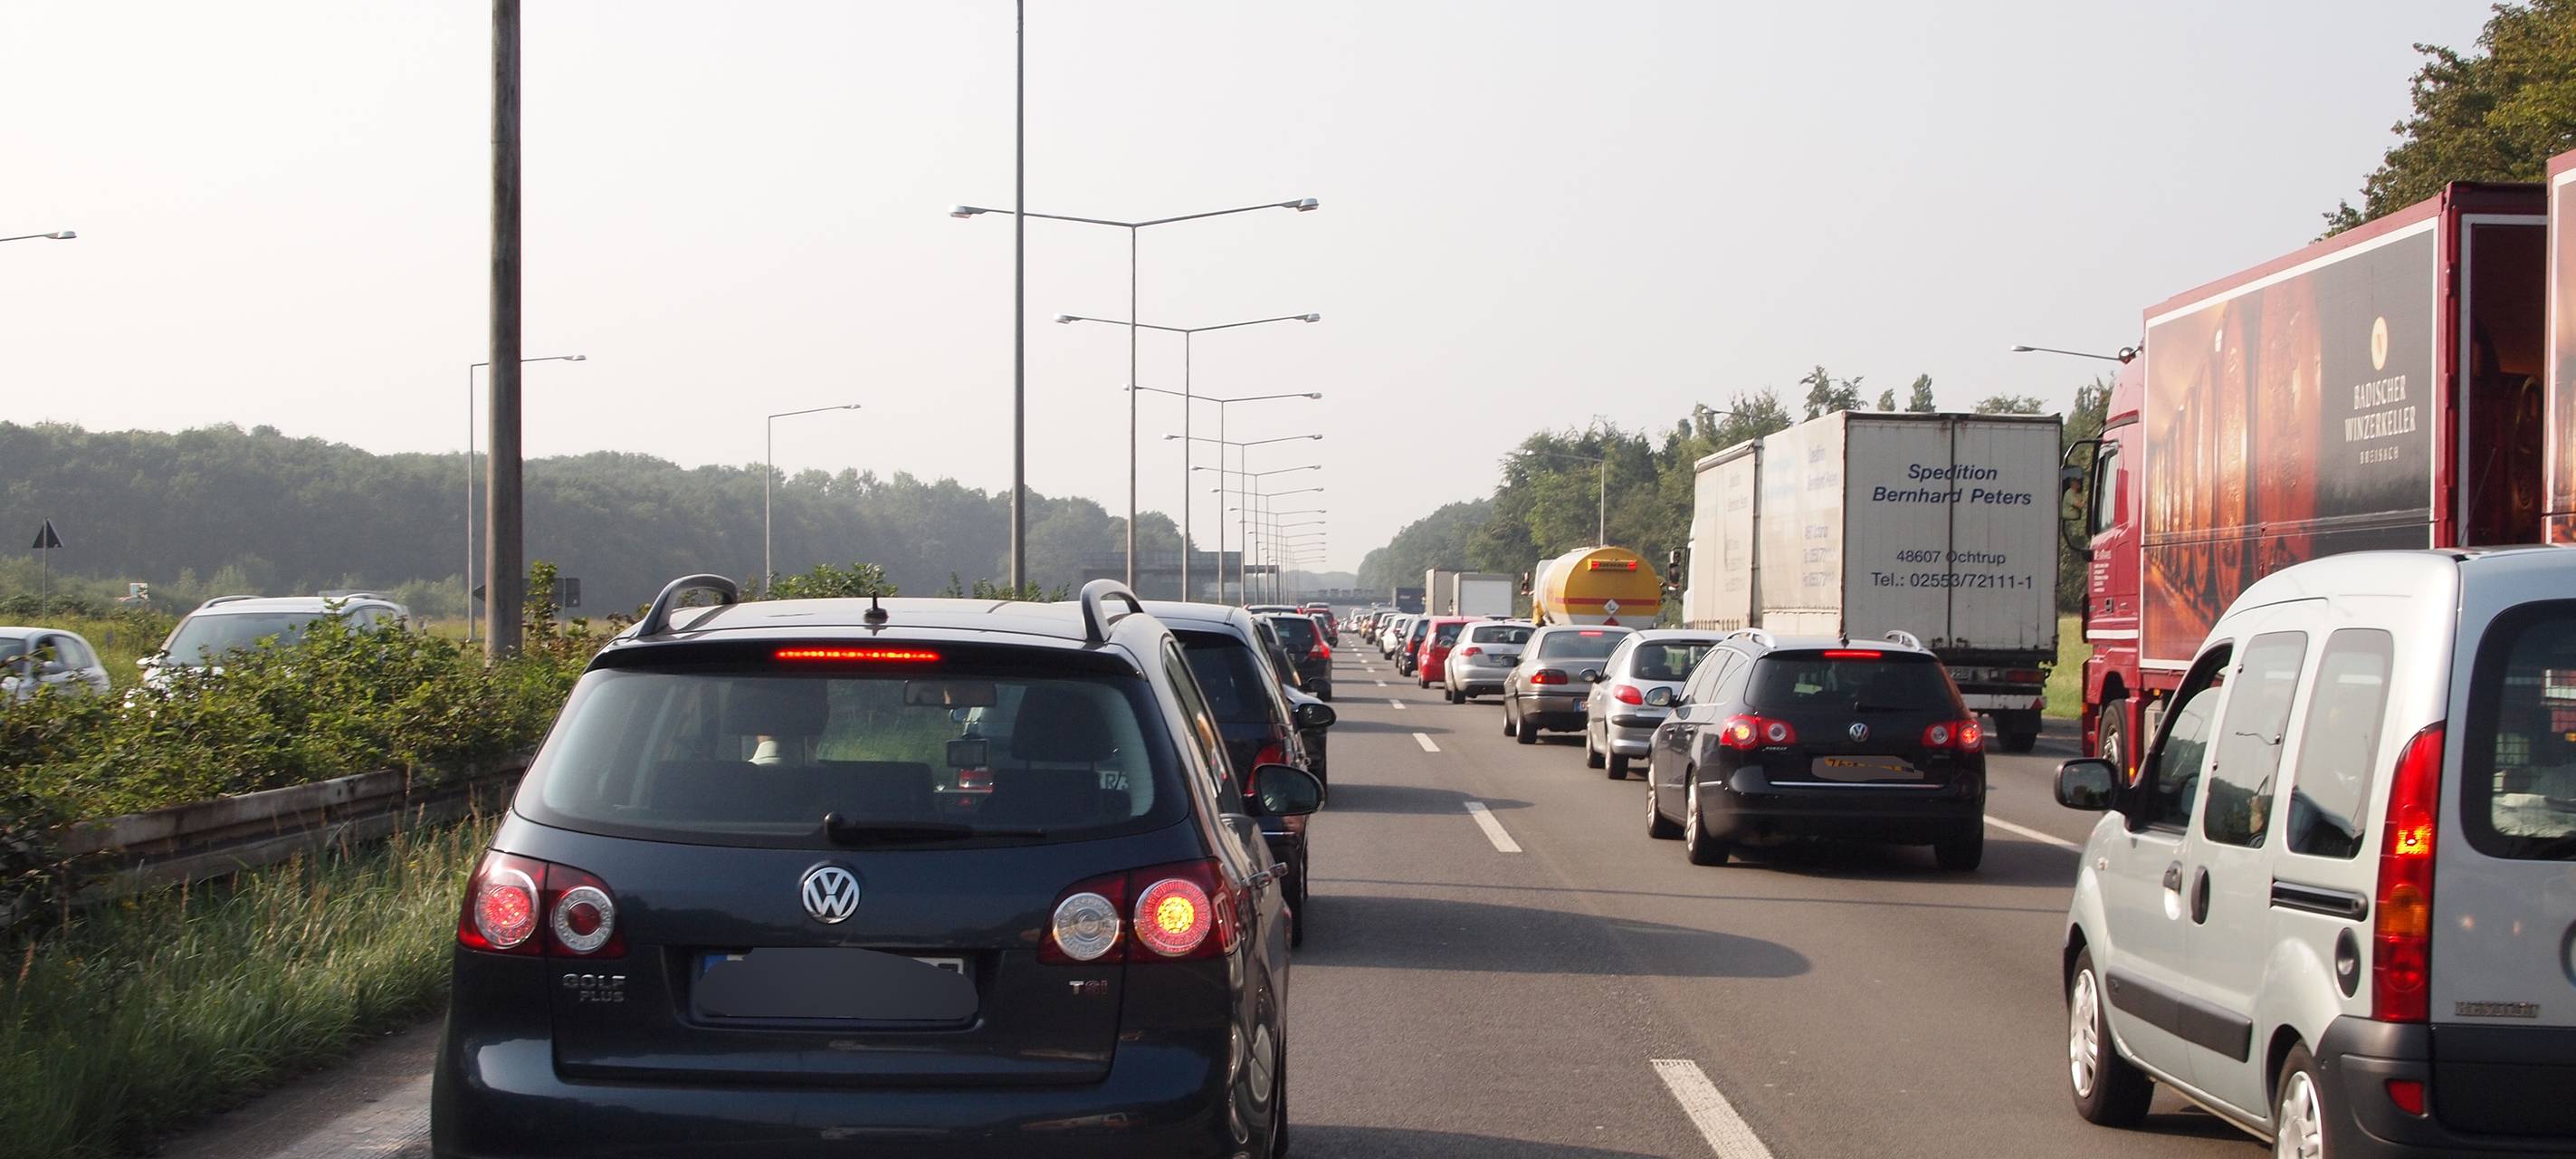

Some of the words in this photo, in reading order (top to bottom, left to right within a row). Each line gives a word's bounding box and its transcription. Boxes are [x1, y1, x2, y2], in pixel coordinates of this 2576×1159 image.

[2354, 375, 2406, 410] BADISCHER
[2345, 406, 2416, 442] WINZERKELLER
[1908, 464, 1998, 483] Spedition
[1873, 486, 1962, 503] Bernhard
[1970, 488, 2032, 505] Peters
[1896, 550, 1941, 563] 48607
[1946, 551, 2006, 567] Ochtrup
[1872, 572, 1904, 587] Tel.:
[1910, 573, 2033, 589] 02553/72111-1
[804, 867, 859, 922] VW
[563, 973, 625, 990] GOLF
[579, 991, 625, 1002] PLUS
